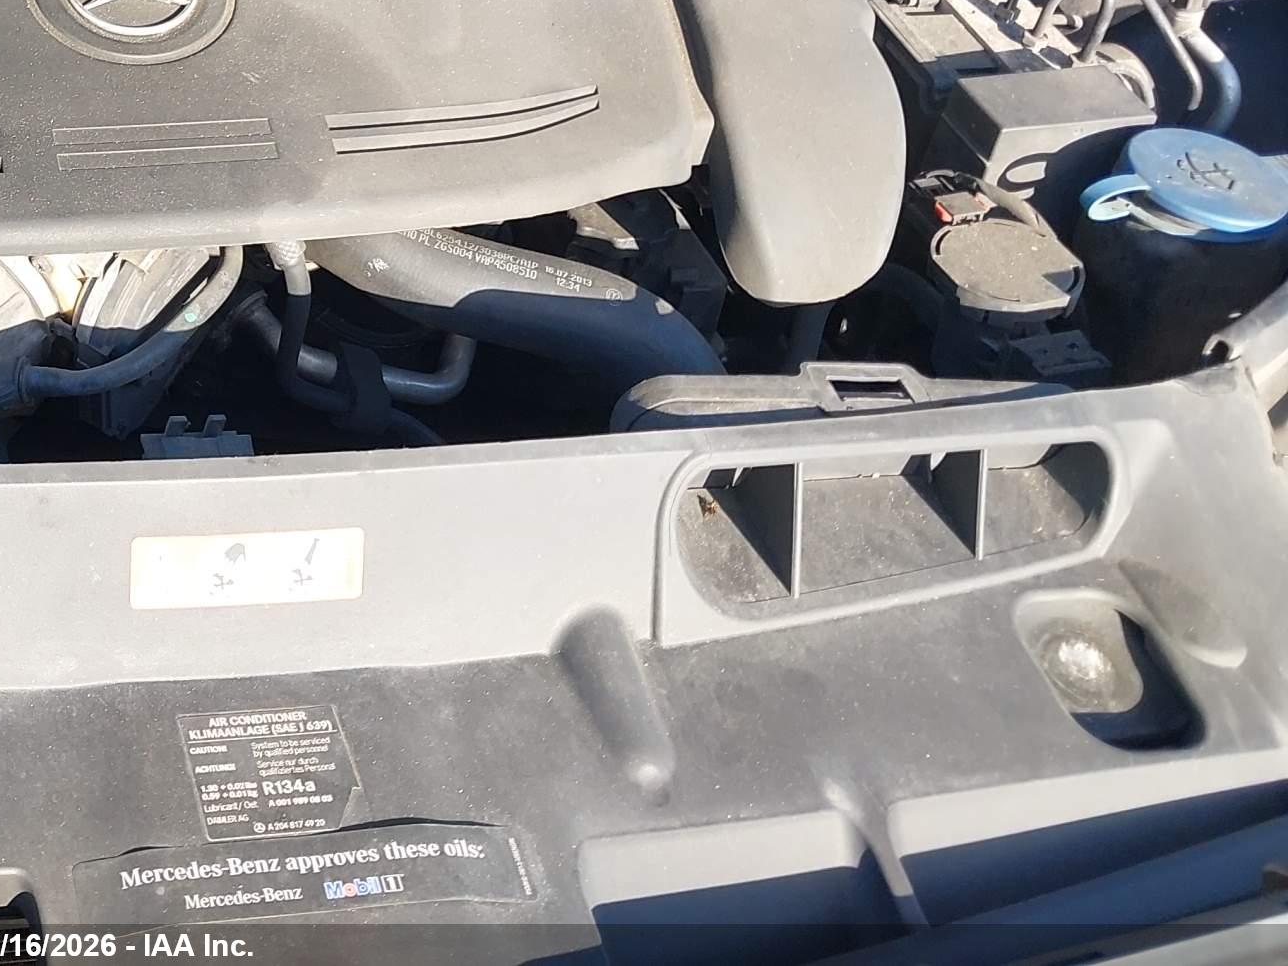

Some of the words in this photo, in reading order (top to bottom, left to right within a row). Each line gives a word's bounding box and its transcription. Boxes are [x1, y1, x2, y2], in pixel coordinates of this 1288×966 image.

[209, 716, 228, 727] AIR
[230, 711, 308, 726] CONDITIONER
[189, 724, 270, 740] KLIMAANLAGE
[262, 779, 316, 796] R134a
[119, 855, 281, 890] Mercedes-Benz
[285, 846, 380, 875] approves
[383, 840, 441, 861] these
[443, 838, 486, 860] oils:
[184, 886, 304, 910] Mercedes-Benz
[323, 876, 381, 900] Mobil
